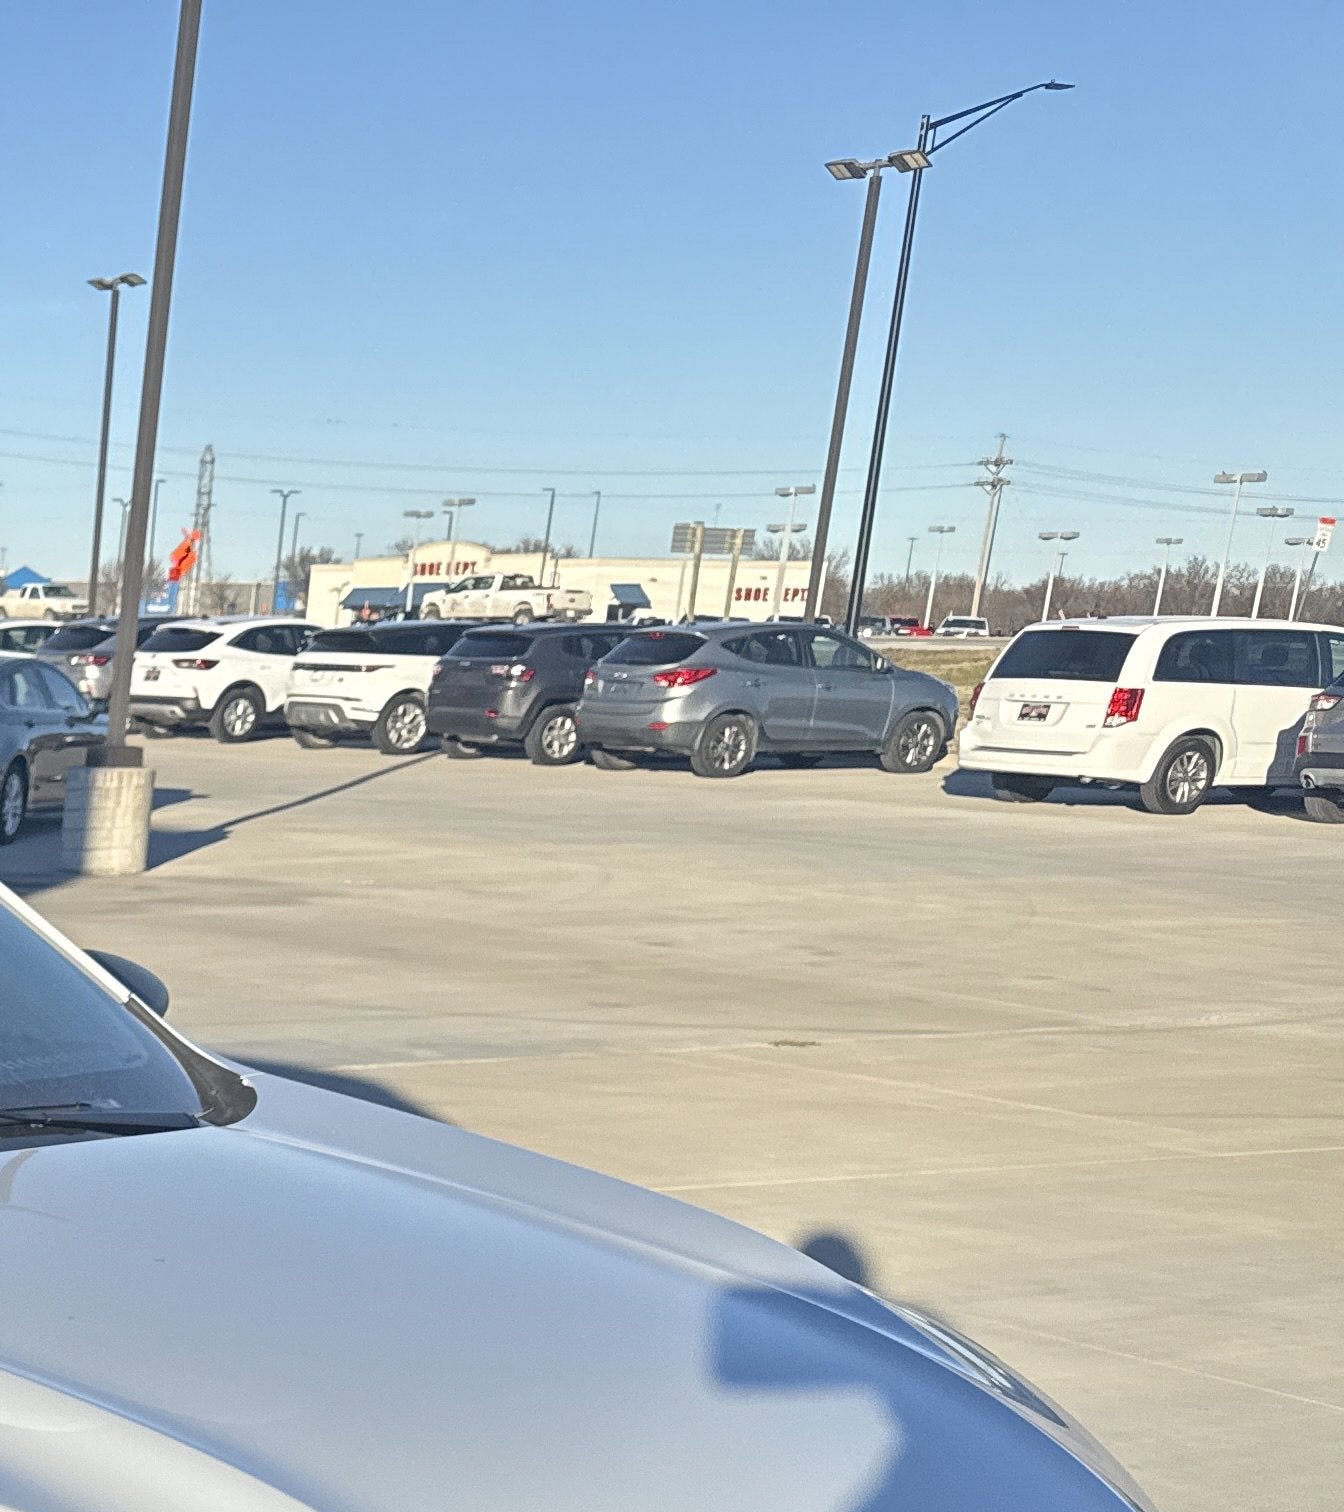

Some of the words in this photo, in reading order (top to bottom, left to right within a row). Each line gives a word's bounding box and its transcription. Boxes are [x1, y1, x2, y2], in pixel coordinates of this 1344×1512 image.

[413, 562, 442, 576] SHOE
[735, 587, 769, 602] SHOE
[781, 587, 811, 602] EPT
